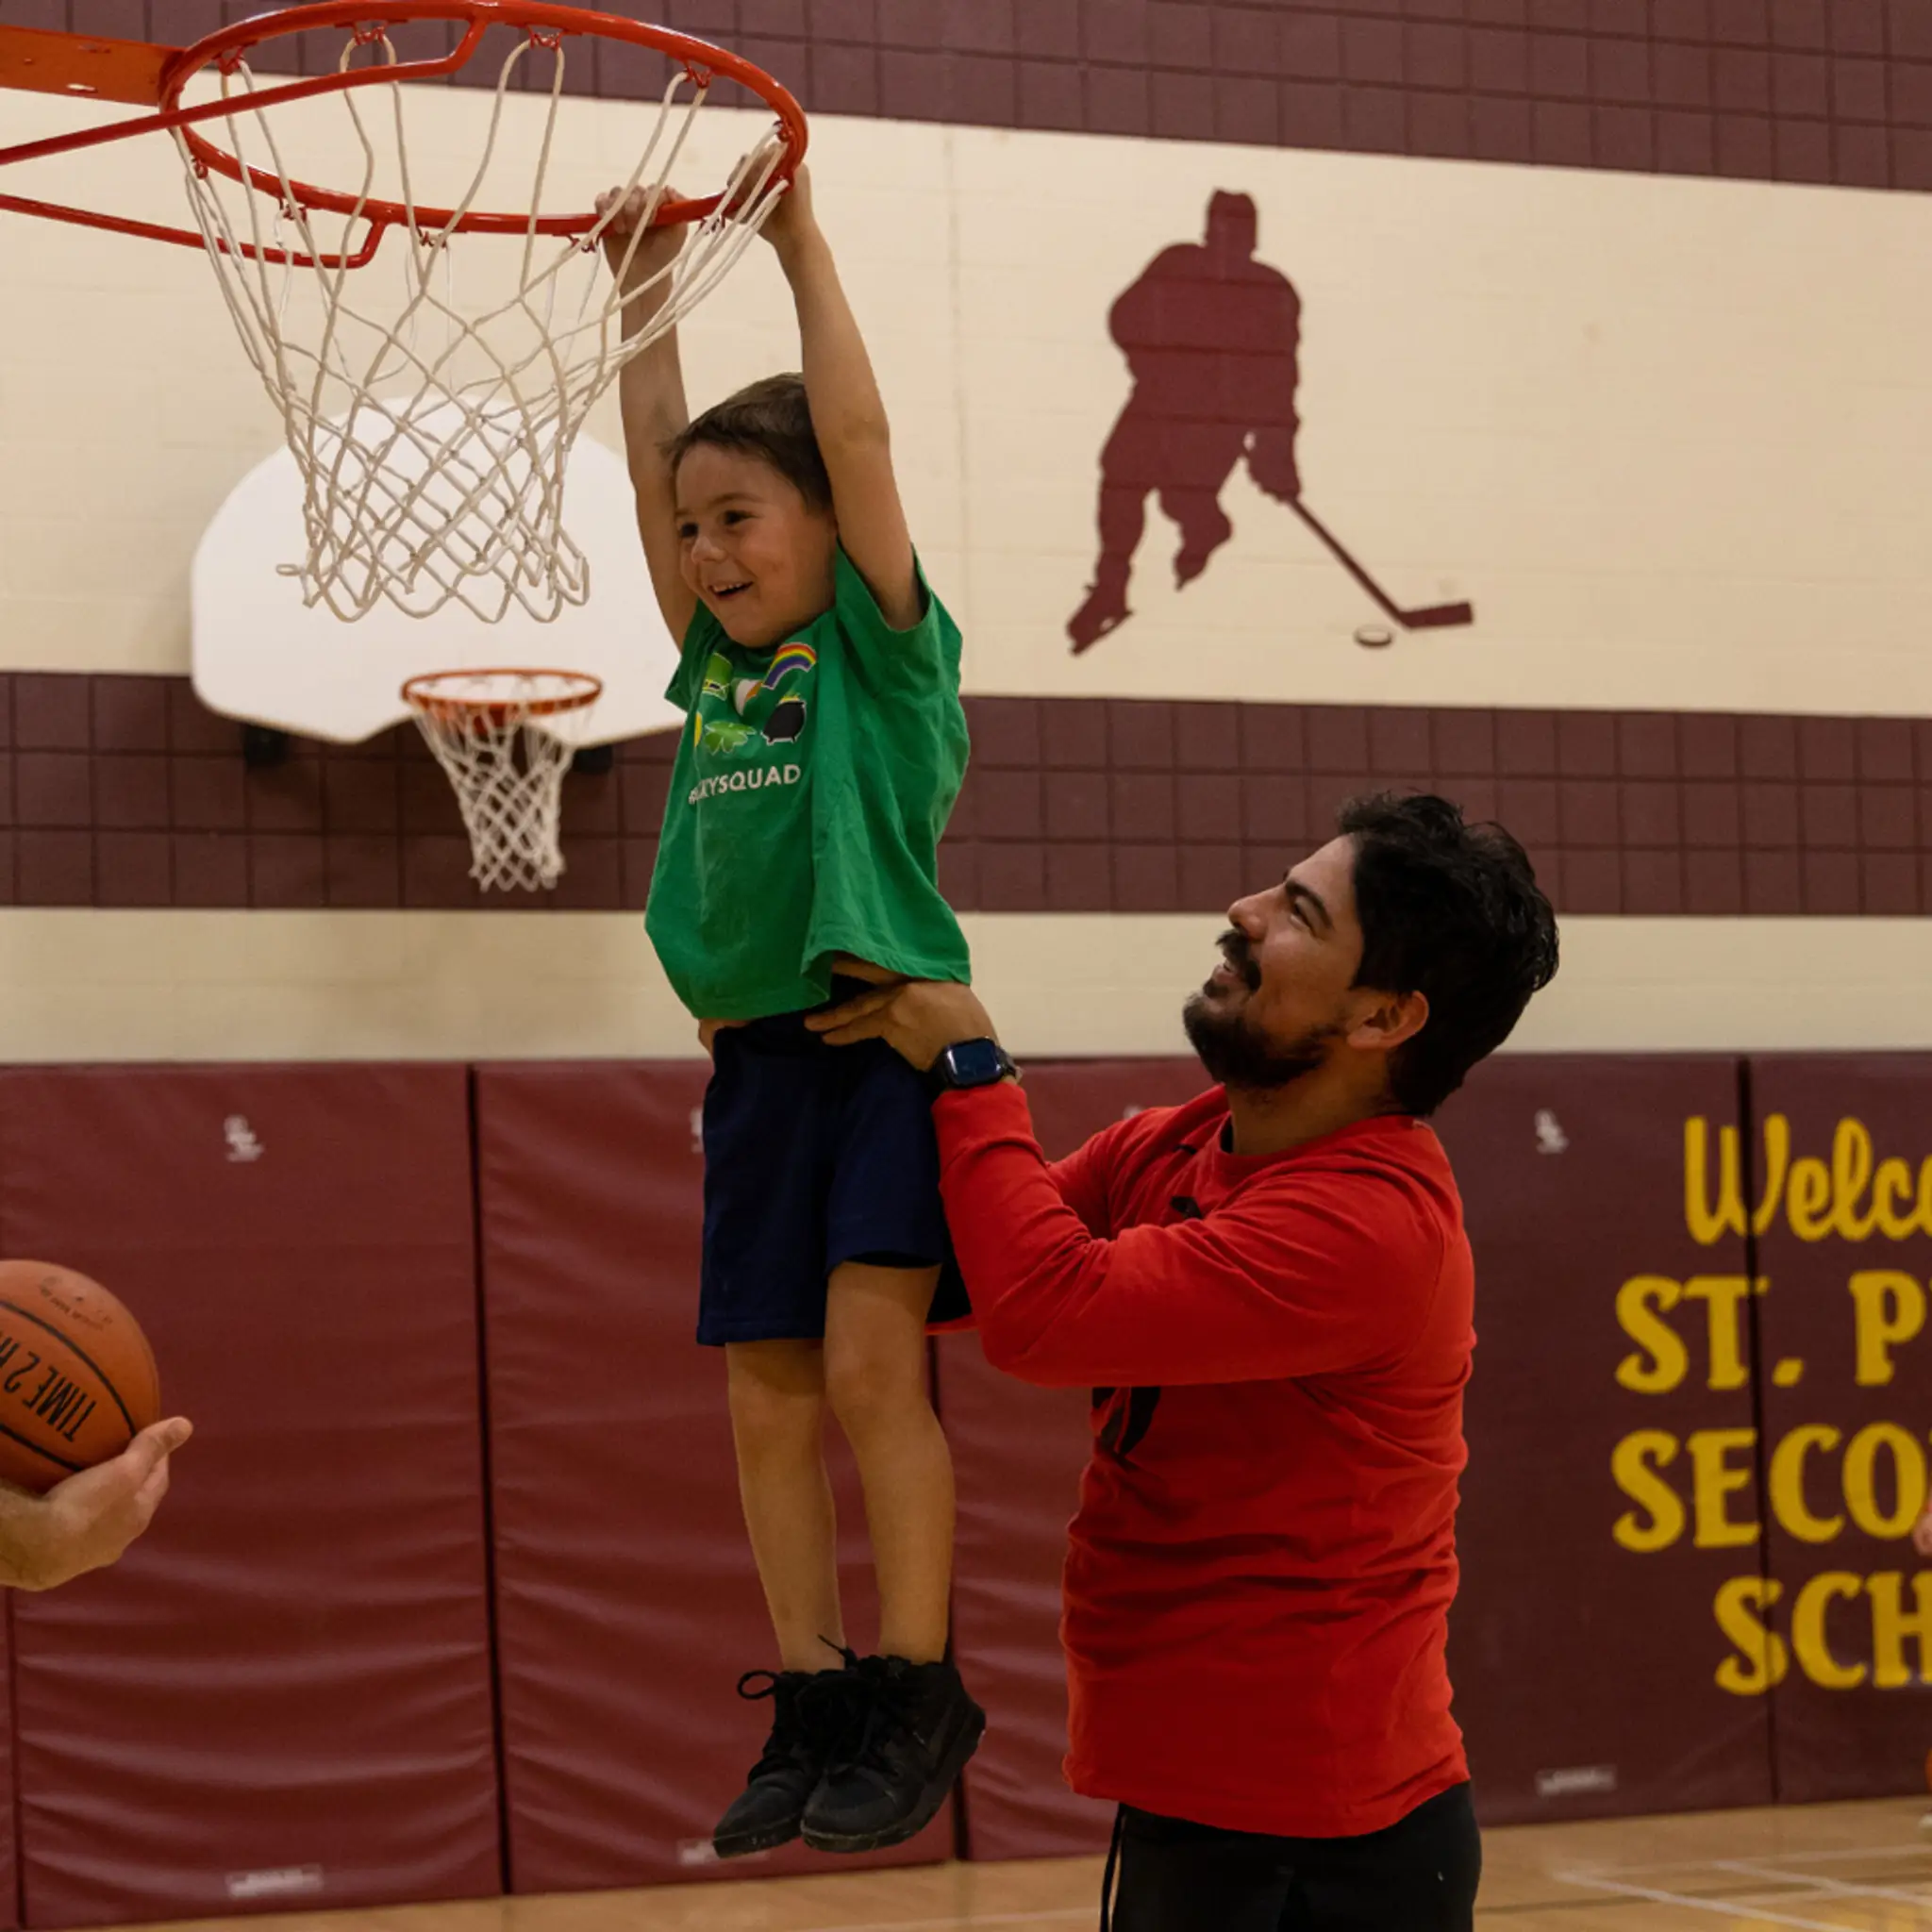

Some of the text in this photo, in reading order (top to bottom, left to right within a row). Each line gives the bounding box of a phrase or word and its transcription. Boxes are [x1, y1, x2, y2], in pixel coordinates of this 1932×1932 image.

[4, 1350, 41, 1393] 2
[1615, 1270, 1932, 1393] ST. P
[23, 1364, 96, 1442] TIME
[1611, 1422, 1932, 1552] SECO
